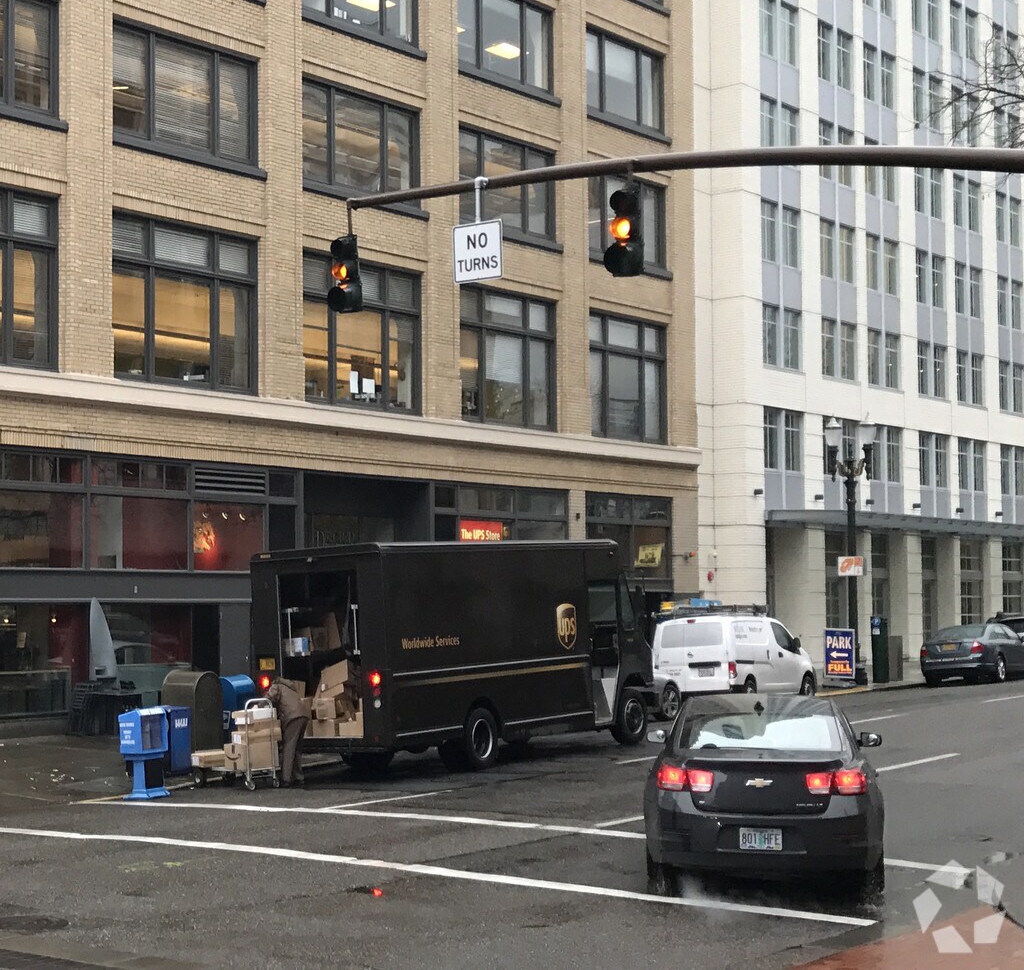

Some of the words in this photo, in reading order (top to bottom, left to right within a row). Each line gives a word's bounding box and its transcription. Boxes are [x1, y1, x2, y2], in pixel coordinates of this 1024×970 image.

[467, 232, 488, 250] NO
[458, 256, 498, 273] TURNS
[461, 529, 472, 540] The
[473, 529, 485, 540] UPS
[486, 530, 500, 540] Store
[560, 617, 575, 642] ups
[402, 636, 434, 650] Worldwide
[435, 635, 460, 647] Services
[827, 636, 851, 649] PARK
[829, 663, 852, 672] FULL
[741, 833, 757, 844] 801
